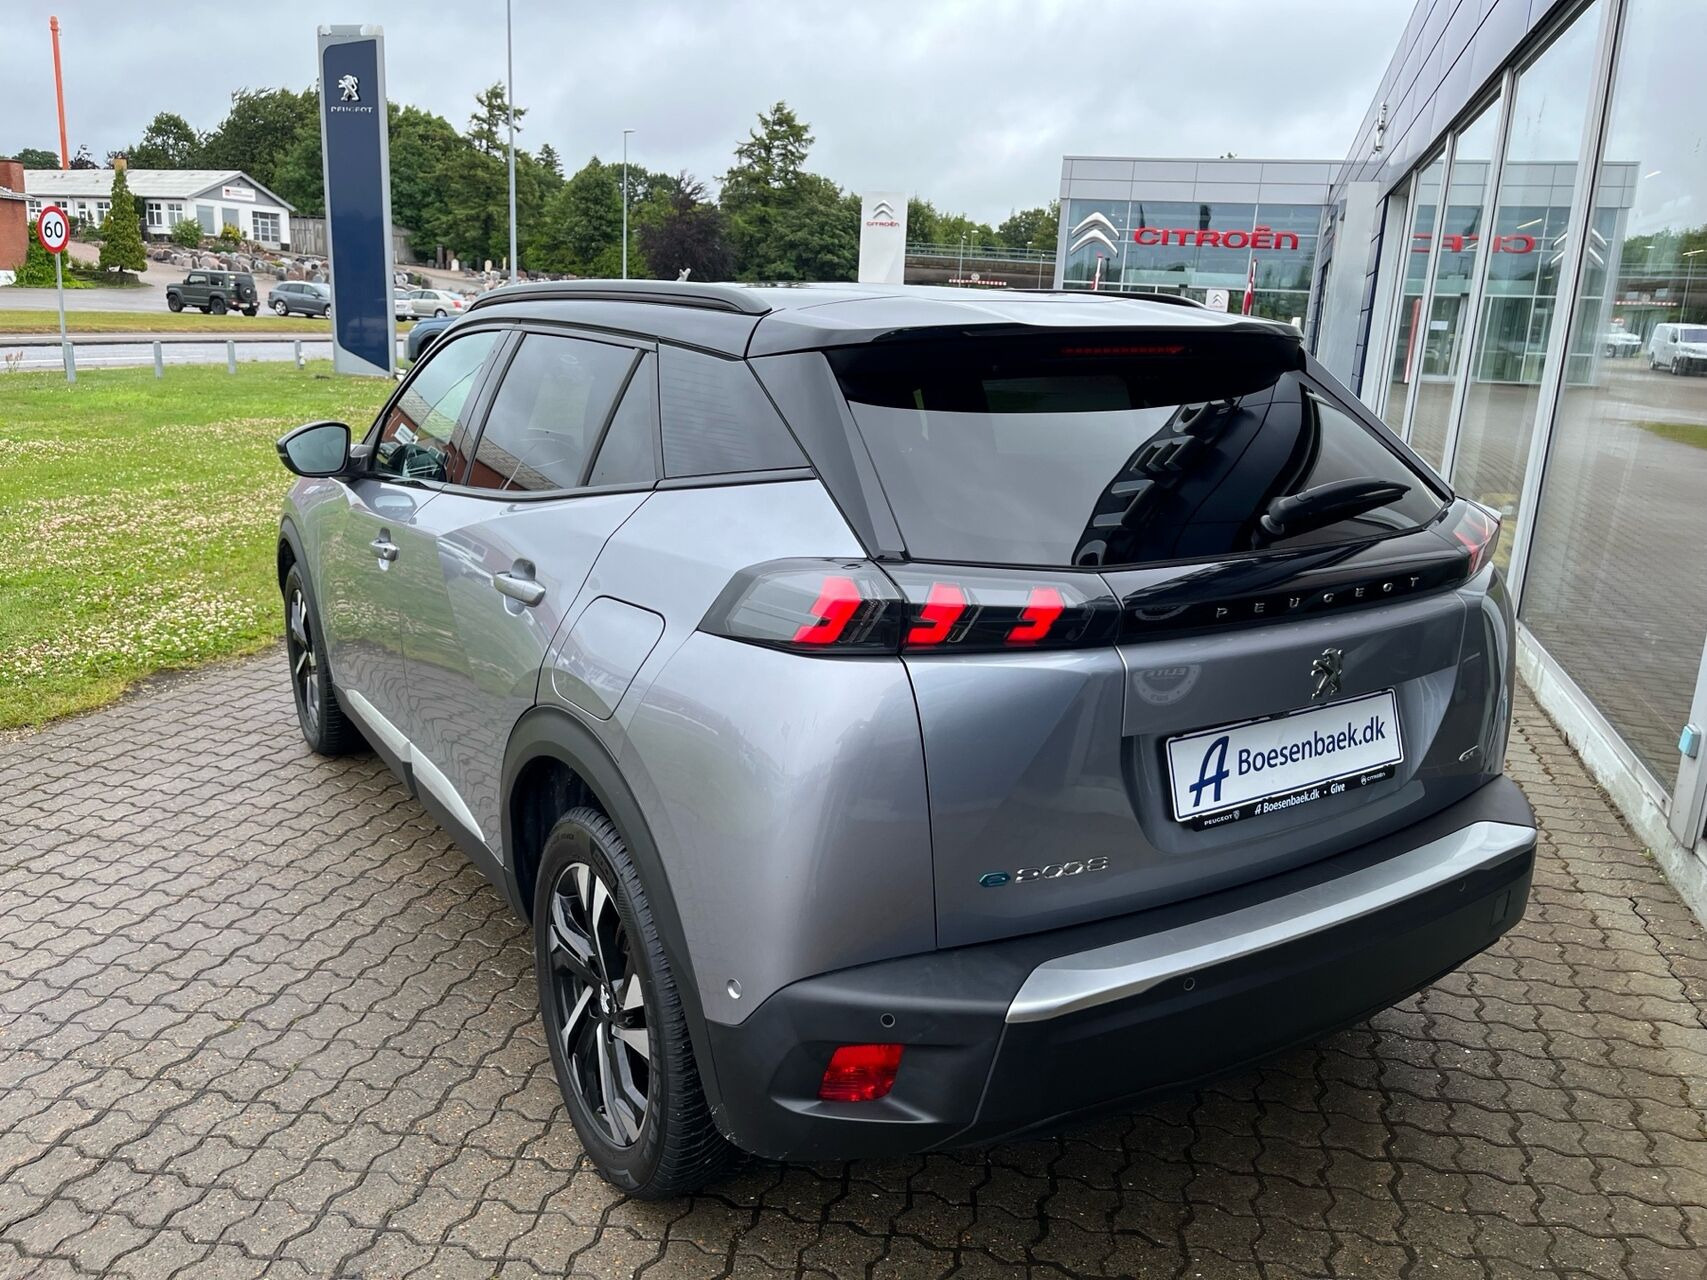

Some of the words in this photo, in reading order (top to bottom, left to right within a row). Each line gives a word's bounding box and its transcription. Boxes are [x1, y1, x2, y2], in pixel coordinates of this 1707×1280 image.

[44, 221, 63, 238] 60
[1133, 224, 1299, 250] CITROËN
[1216, 577, 1419, 618] PEUGEOT
[1238, 715, 1386, 776] Boesenbaek.dk
[1263, 788, 1320, 813] Boesenbaek.dk
[1330, 783, 1346, 794] Give
[1204, 813, 1233, 826] PEUGEOT
